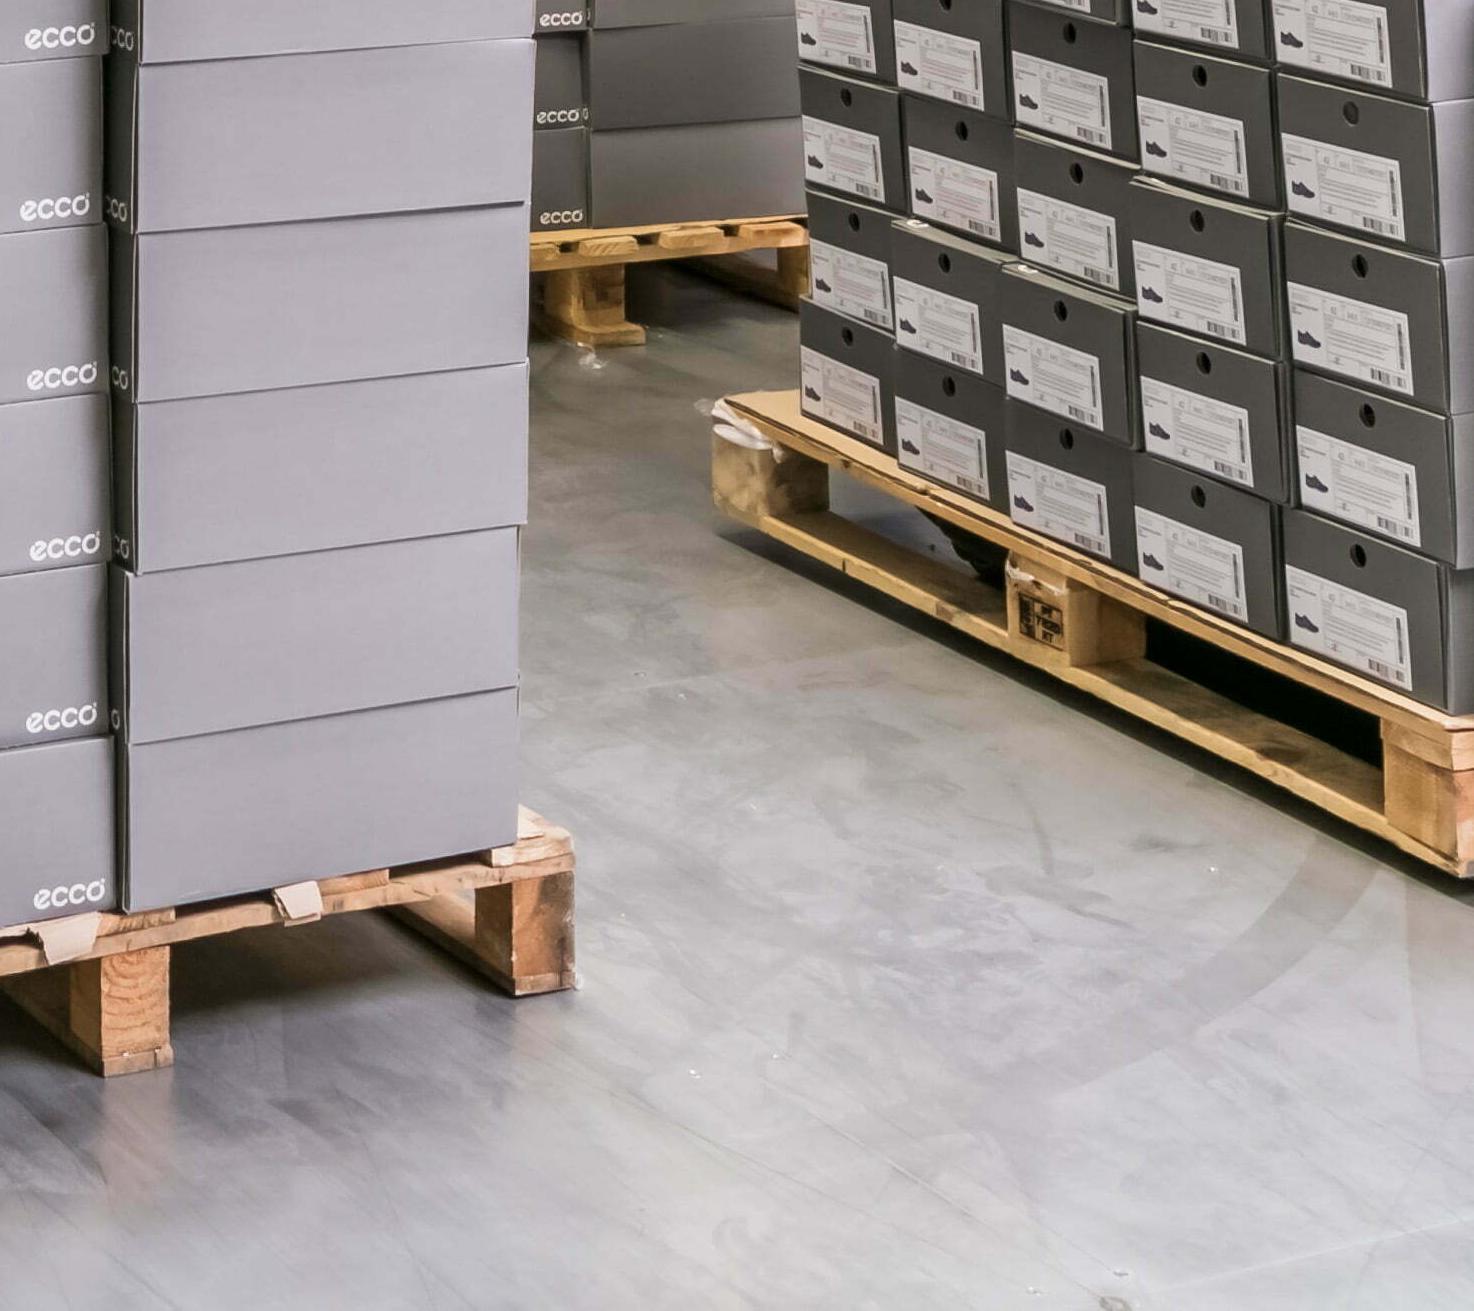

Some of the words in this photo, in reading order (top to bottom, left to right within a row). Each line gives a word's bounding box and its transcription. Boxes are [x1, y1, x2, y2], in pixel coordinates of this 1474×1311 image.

[539, 11, 583, 27] ecco
[24, 25, 94, 51] ecco
[536, 109, 581, 126] ecco
[19, 195, 89, 222] ecco
[539, 209, 583, 225] ecco
[26, 363, 98, 391] ecco
[112, 366, 129, 390] co
[29, 533, 100, 562] ecco
[25, 705, 97, 734] ecco
[33, 877, 107, 912] ecco
